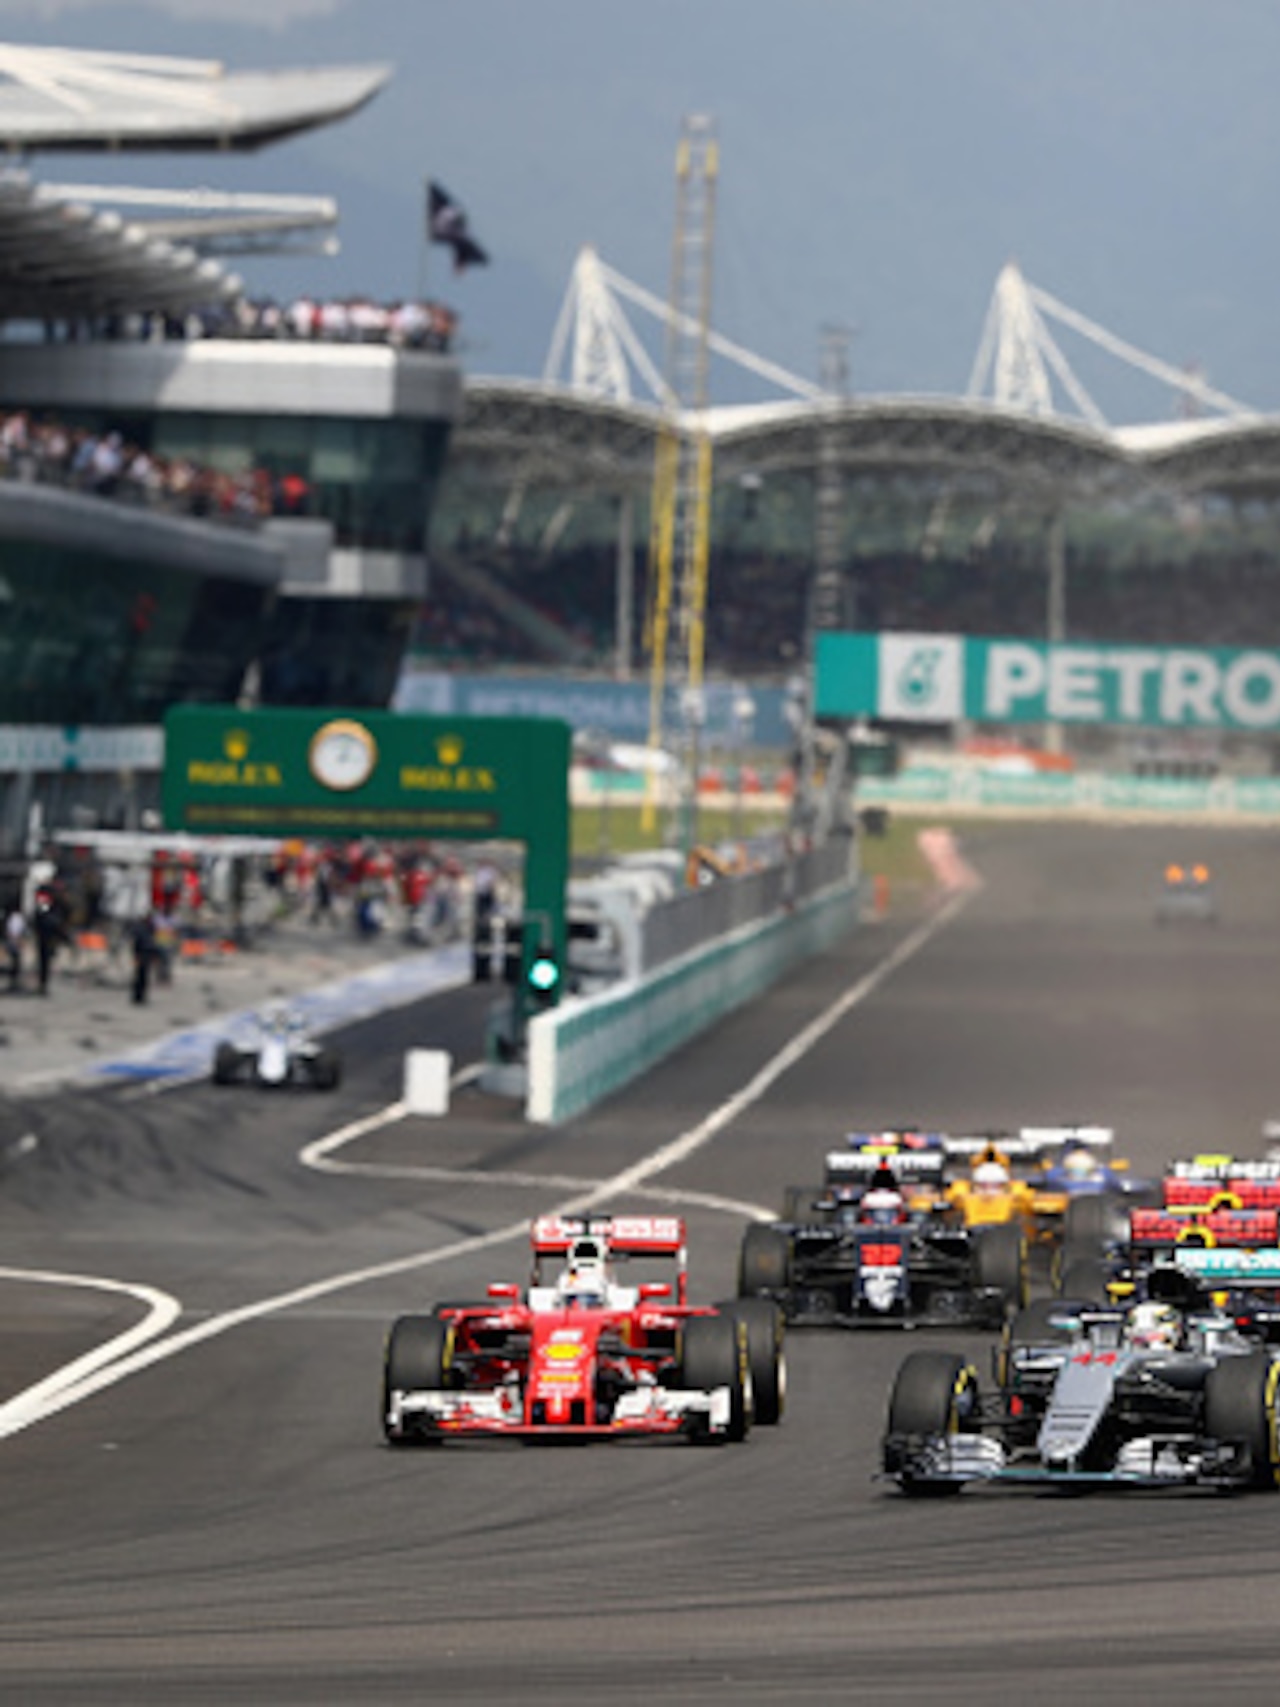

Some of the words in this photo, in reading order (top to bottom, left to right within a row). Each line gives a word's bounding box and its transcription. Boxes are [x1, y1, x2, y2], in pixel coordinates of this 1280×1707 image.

[187, 761, 282, 786] ROLEX
[400, 766, 496, 791] ROLEX
[1071, 1351, 1118, 1367] 44
